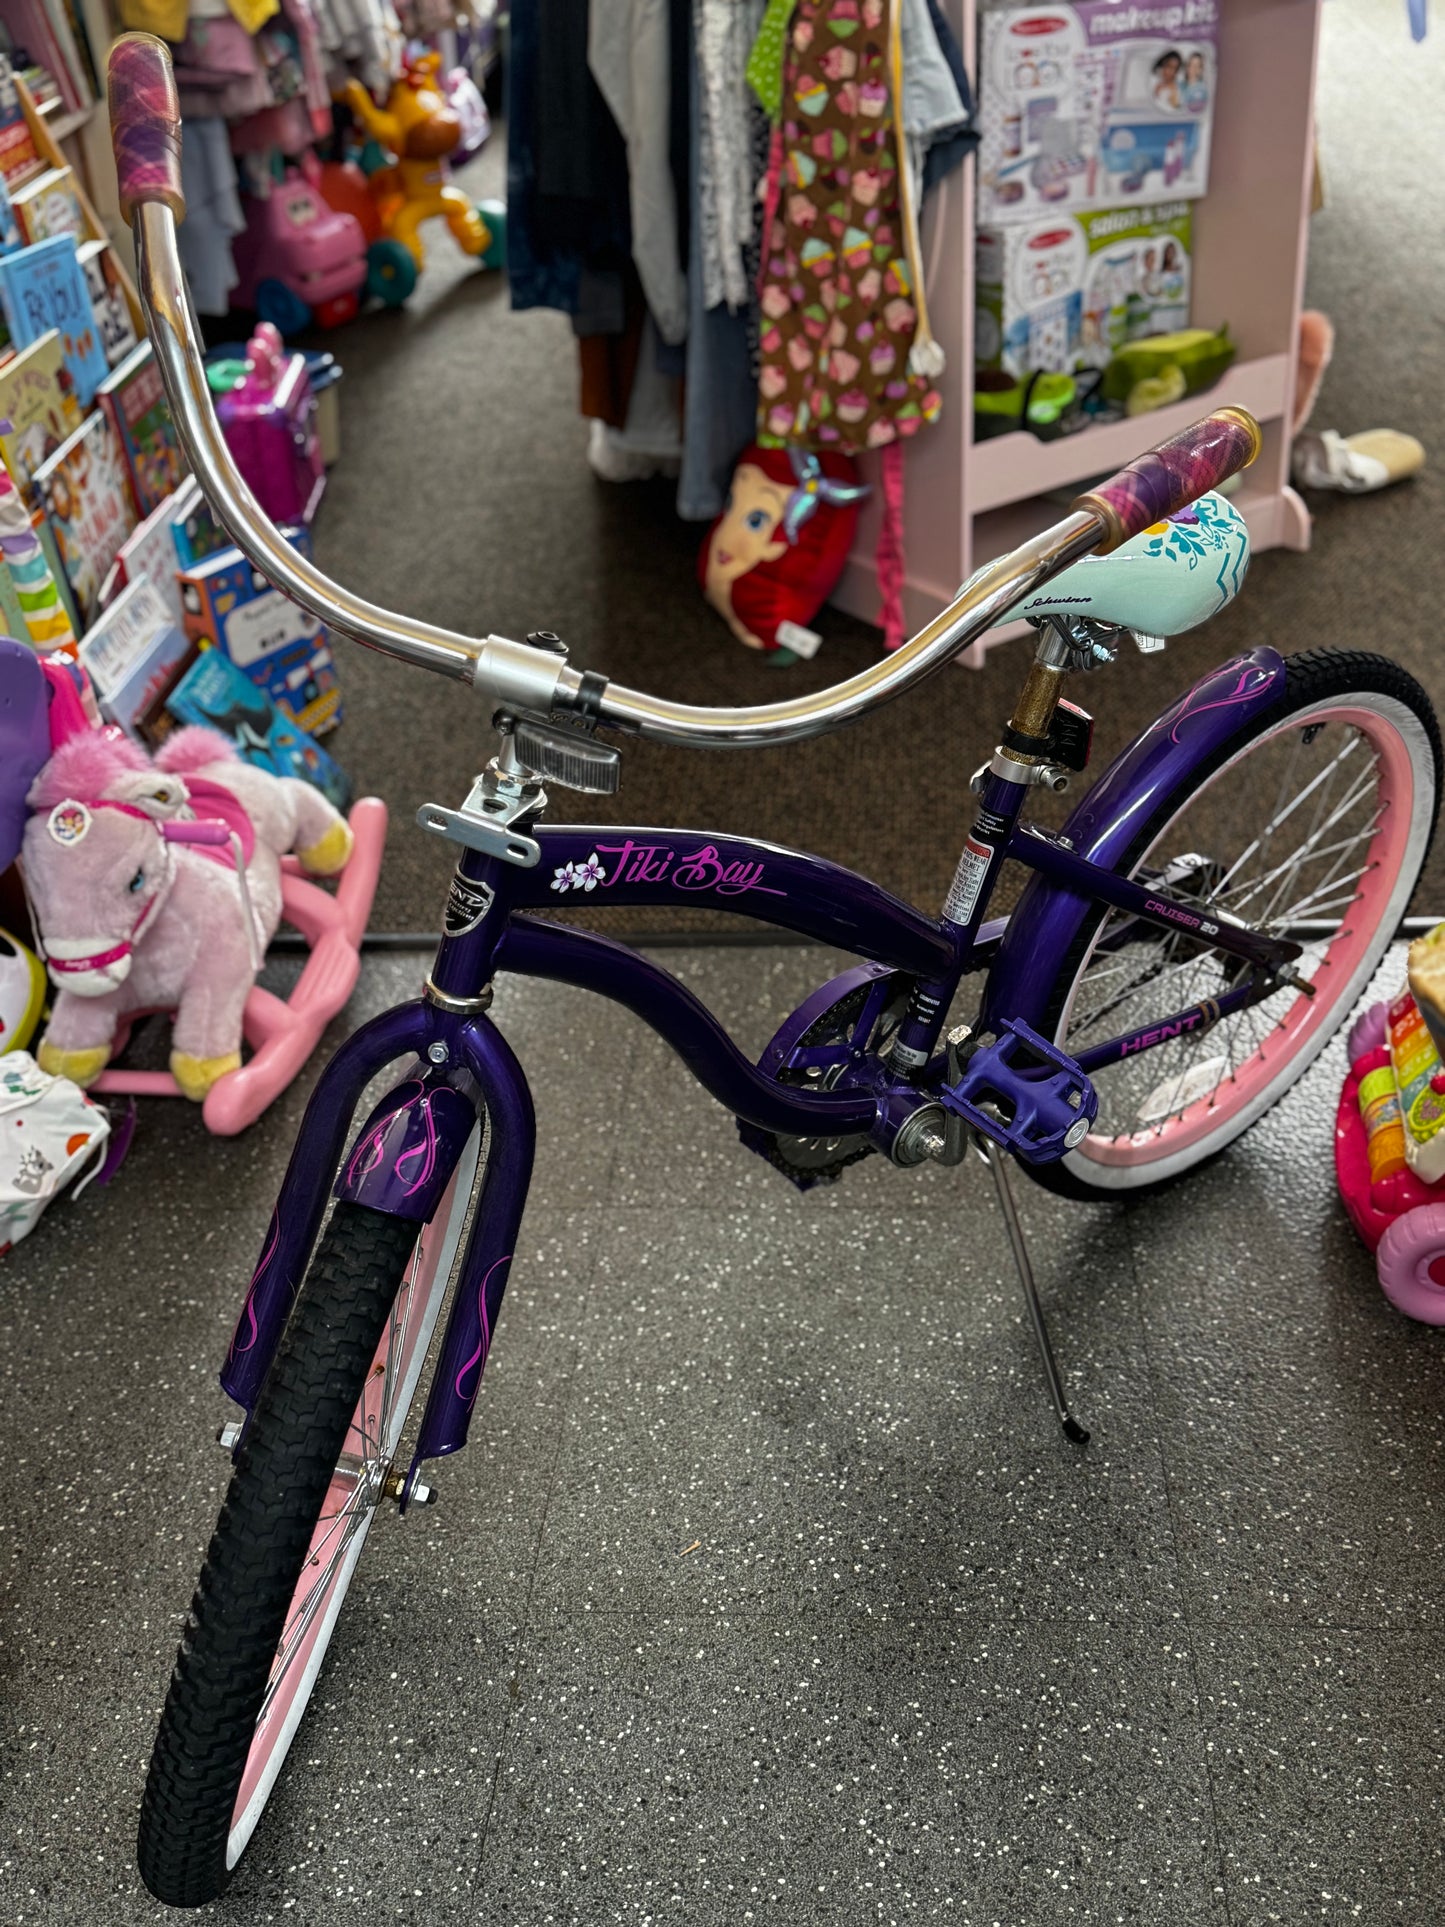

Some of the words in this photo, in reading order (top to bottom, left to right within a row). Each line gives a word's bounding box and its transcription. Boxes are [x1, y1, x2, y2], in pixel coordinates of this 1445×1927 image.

[596, 840, 675, 887] Tiki
[672, 845, 787, 895] Bay
[1144, 899, 1200, 928] CRUISER
[1200, 921, 1219, 935] 20
